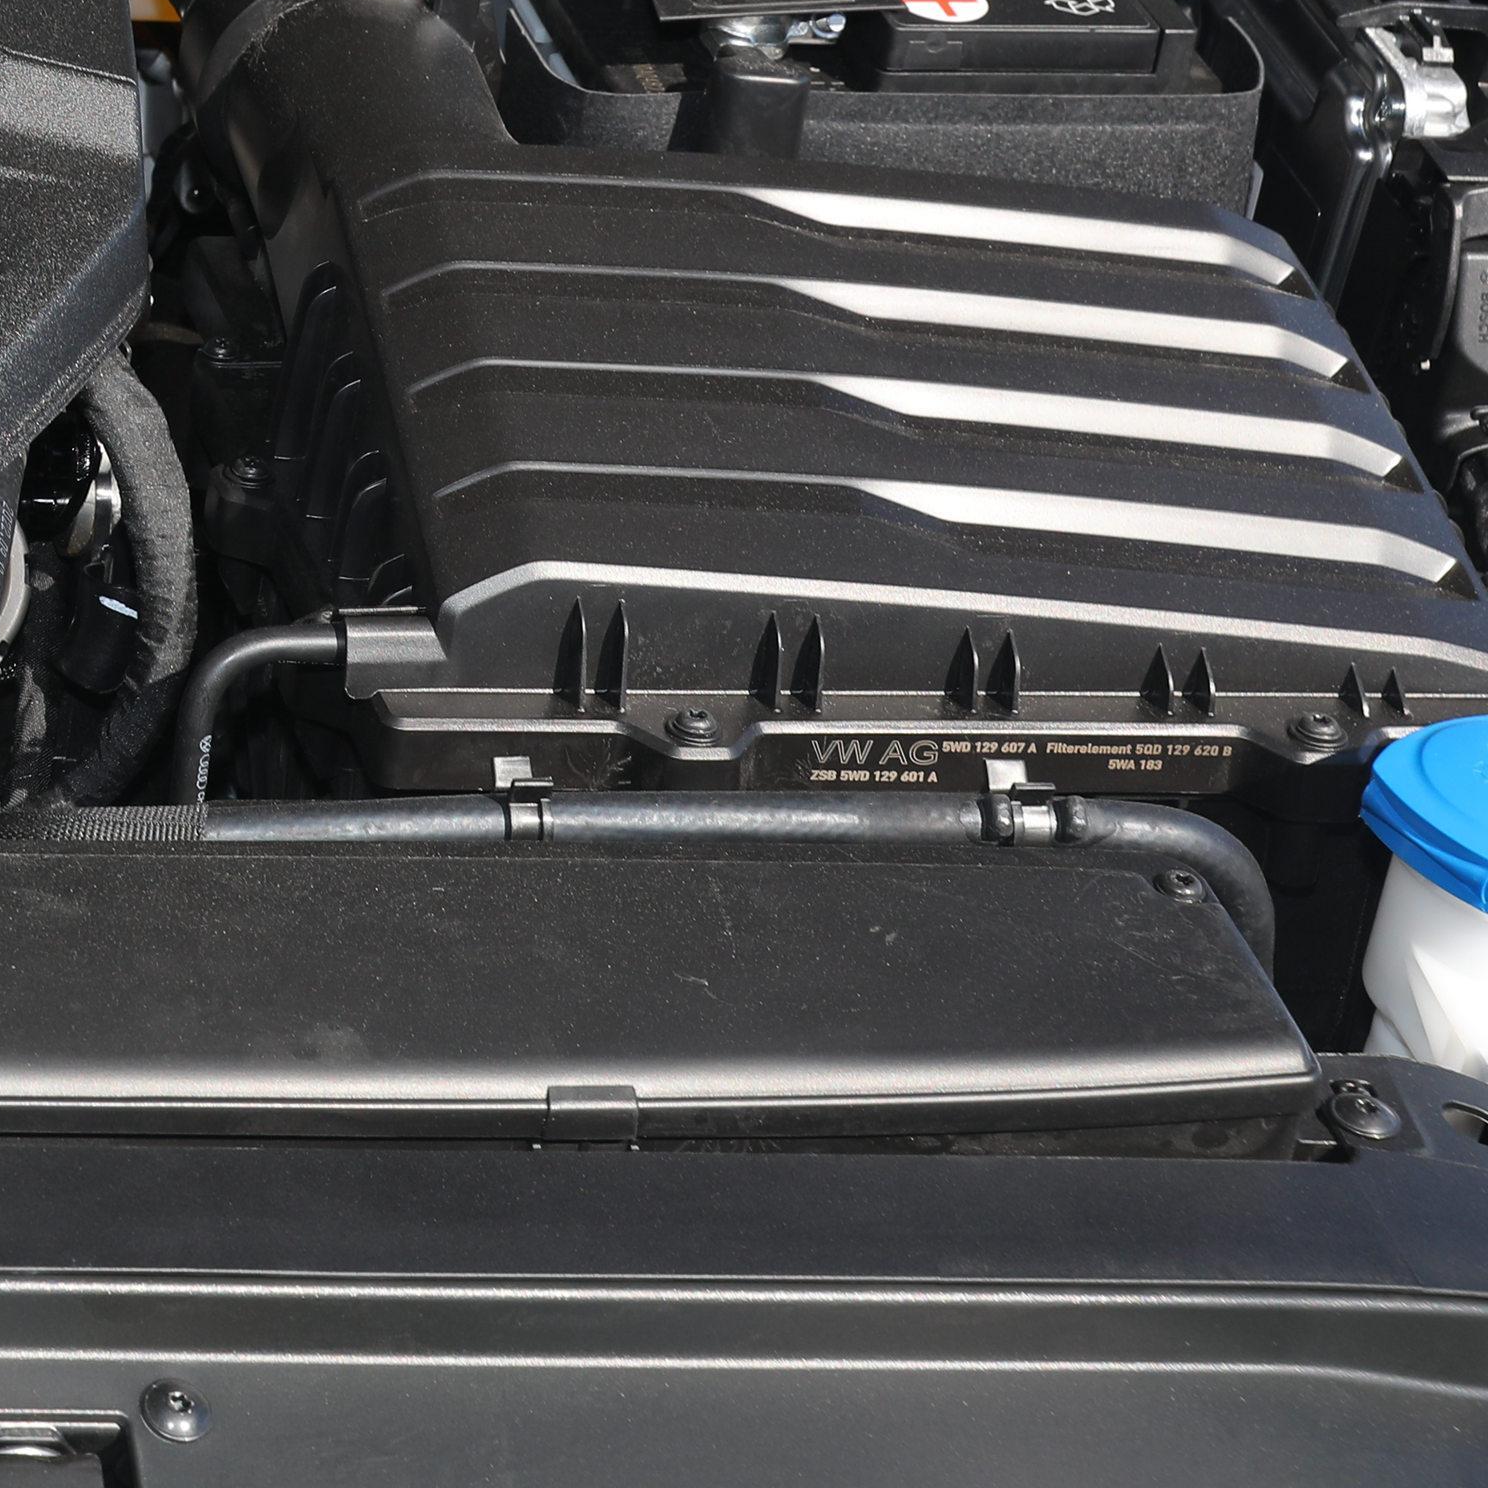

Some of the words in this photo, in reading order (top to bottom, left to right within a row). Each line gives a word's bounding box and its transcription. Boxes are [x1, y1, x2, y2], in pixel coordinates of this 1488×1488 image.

[811, 740, 872, 765] VW
[879, 739, 940, 765] AG
[942, 742, 972, 754] 5WD
[974, 742, 999, 754] 129
[1001, 742, 1026, 754] 607
[1027, 743, 1038, 755] A
[1046, 742, 1132, 755] Filterelement
[1166, 744, 1191, 756] 129
[1194, 745, 1220, 757] 620
[1223, 745, 1232, 757] B
[1108, 759, 1137, 771] 5WA
[1139, 759, 1163, 771] 183
[810, 770, 837, 783] ZSB
[840, 770, 871, 783] 5WD
[873, 770, 899, 783] 129
[901, 771, 925, 783] 601
[927, 771, 938, 783] A
